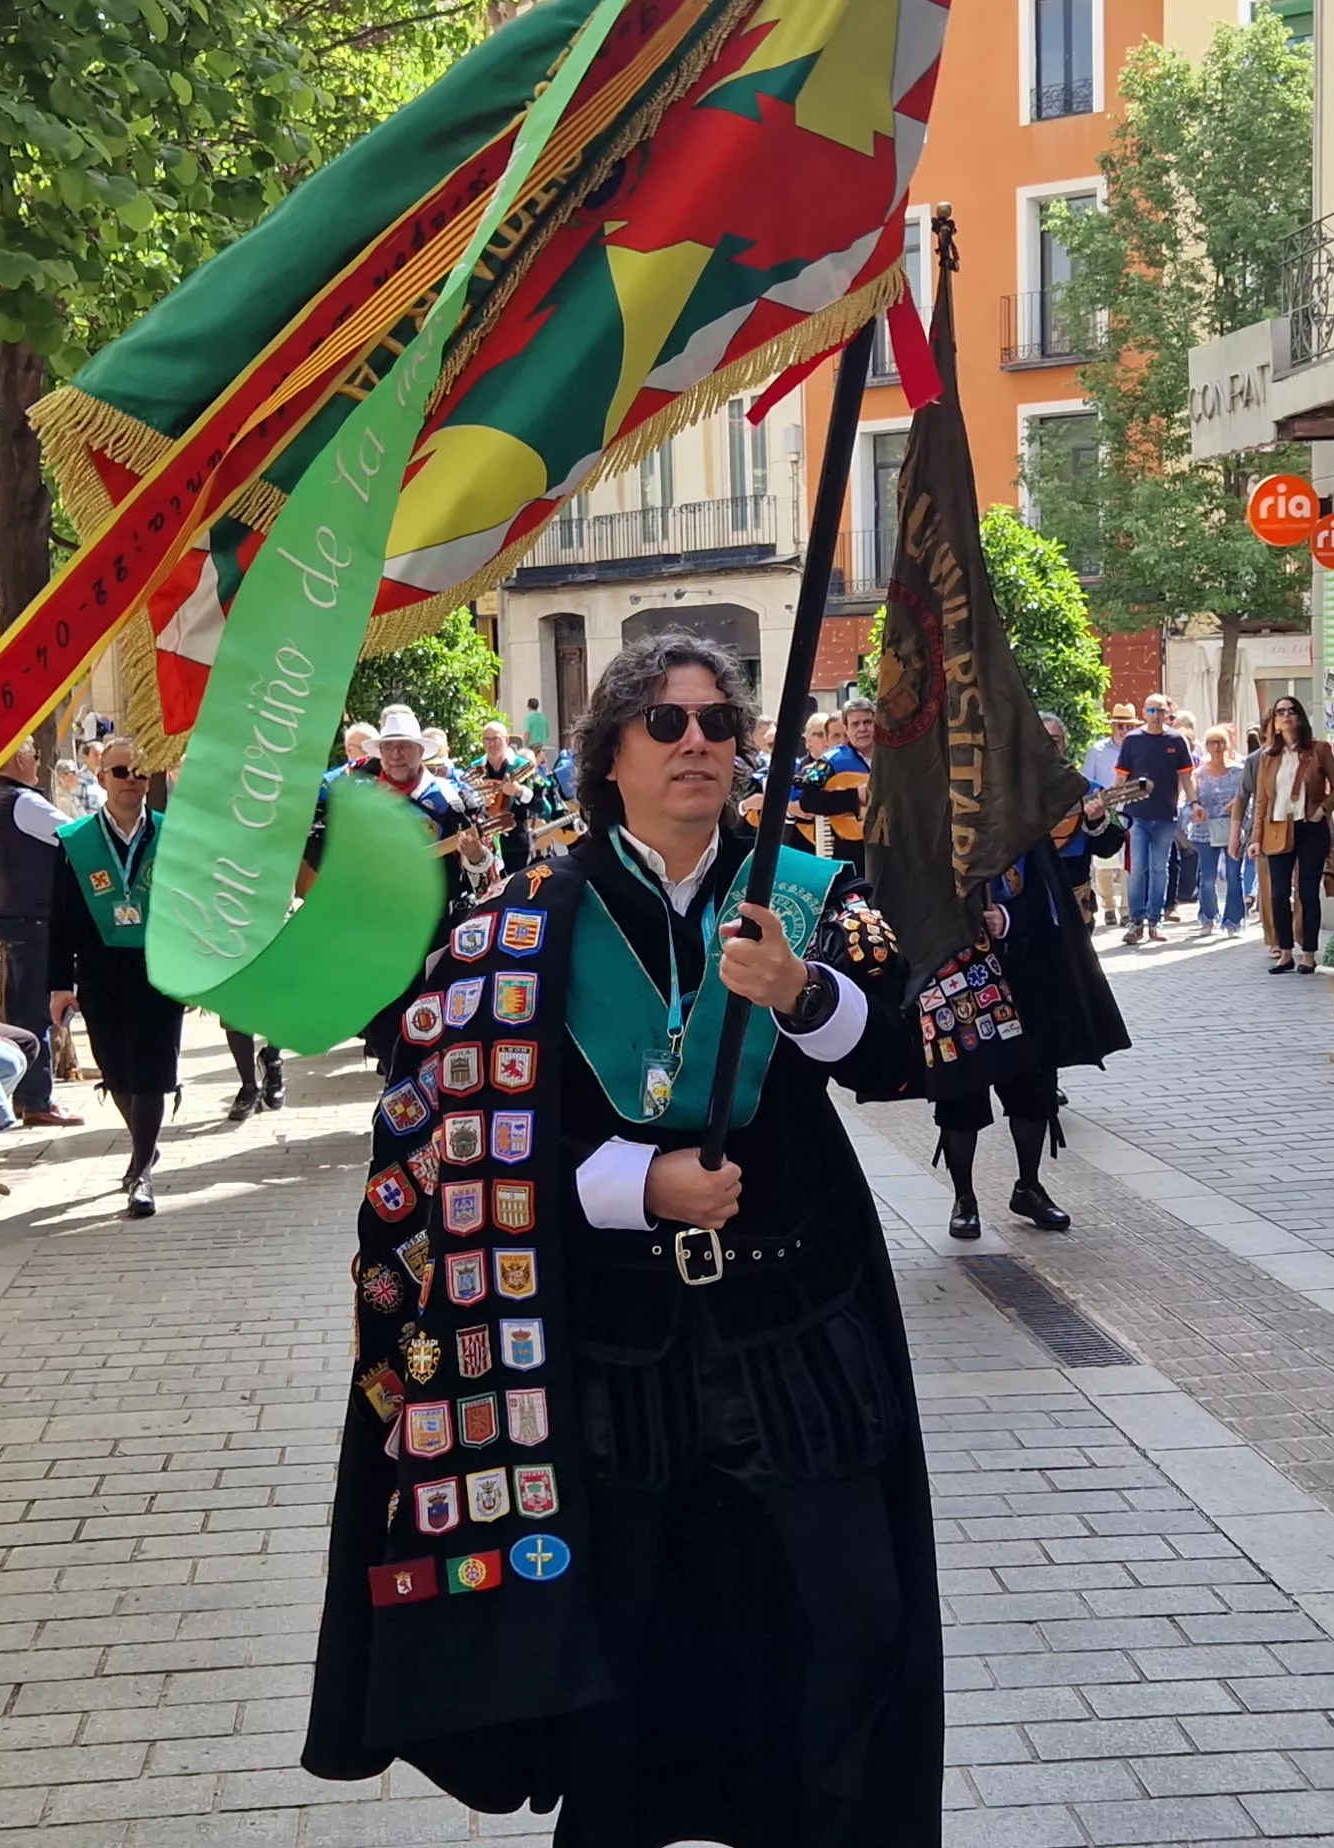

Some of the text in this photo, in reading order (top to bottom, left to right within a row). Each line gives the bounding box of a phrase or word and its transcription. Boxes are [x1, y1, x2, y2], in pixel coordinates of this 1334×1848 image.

[1259, 483, 1312, 519] ria
[172, 424, 386, 960] Con cariño de la
